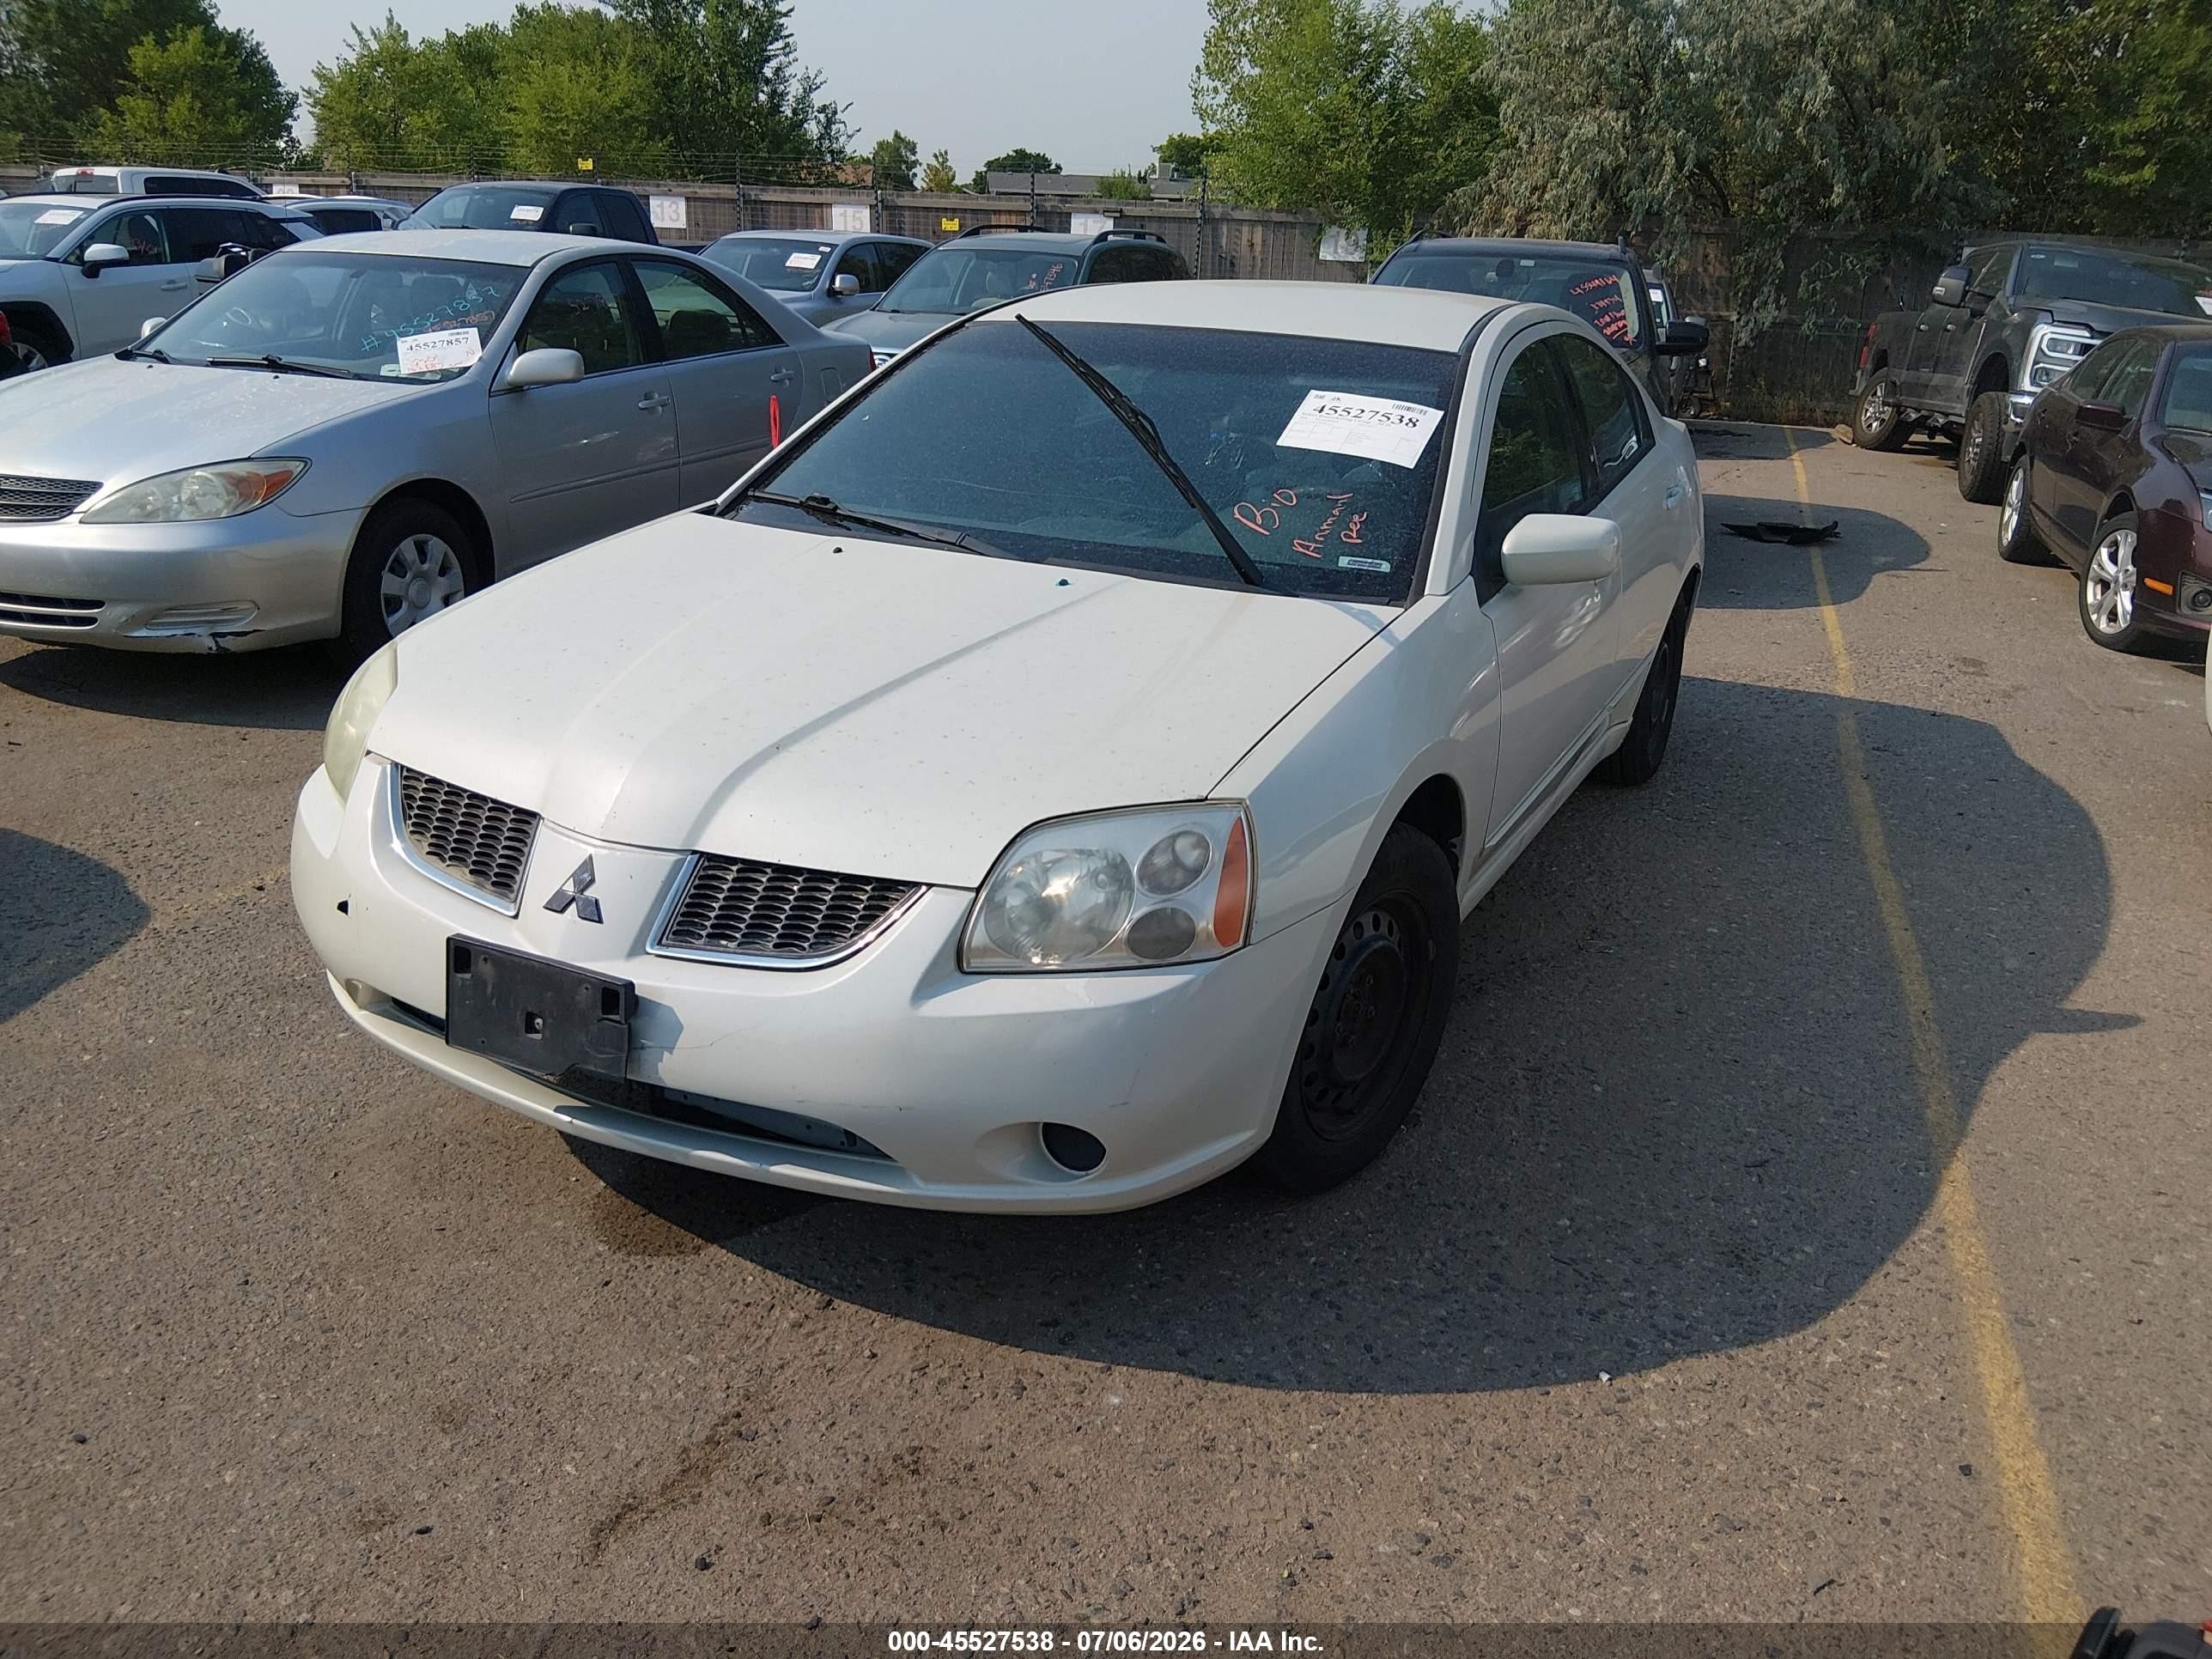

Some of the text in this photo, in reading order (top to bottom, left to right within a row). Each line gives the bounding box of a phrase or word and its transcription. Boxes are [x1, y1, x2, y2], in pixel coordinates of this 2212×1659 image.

[657, 200, 680, 222] 13
[840, 210, 864, 231] 15
[406, 337, 470, 352] 45527857
[1313, 403, 1419, 428] 45527538
